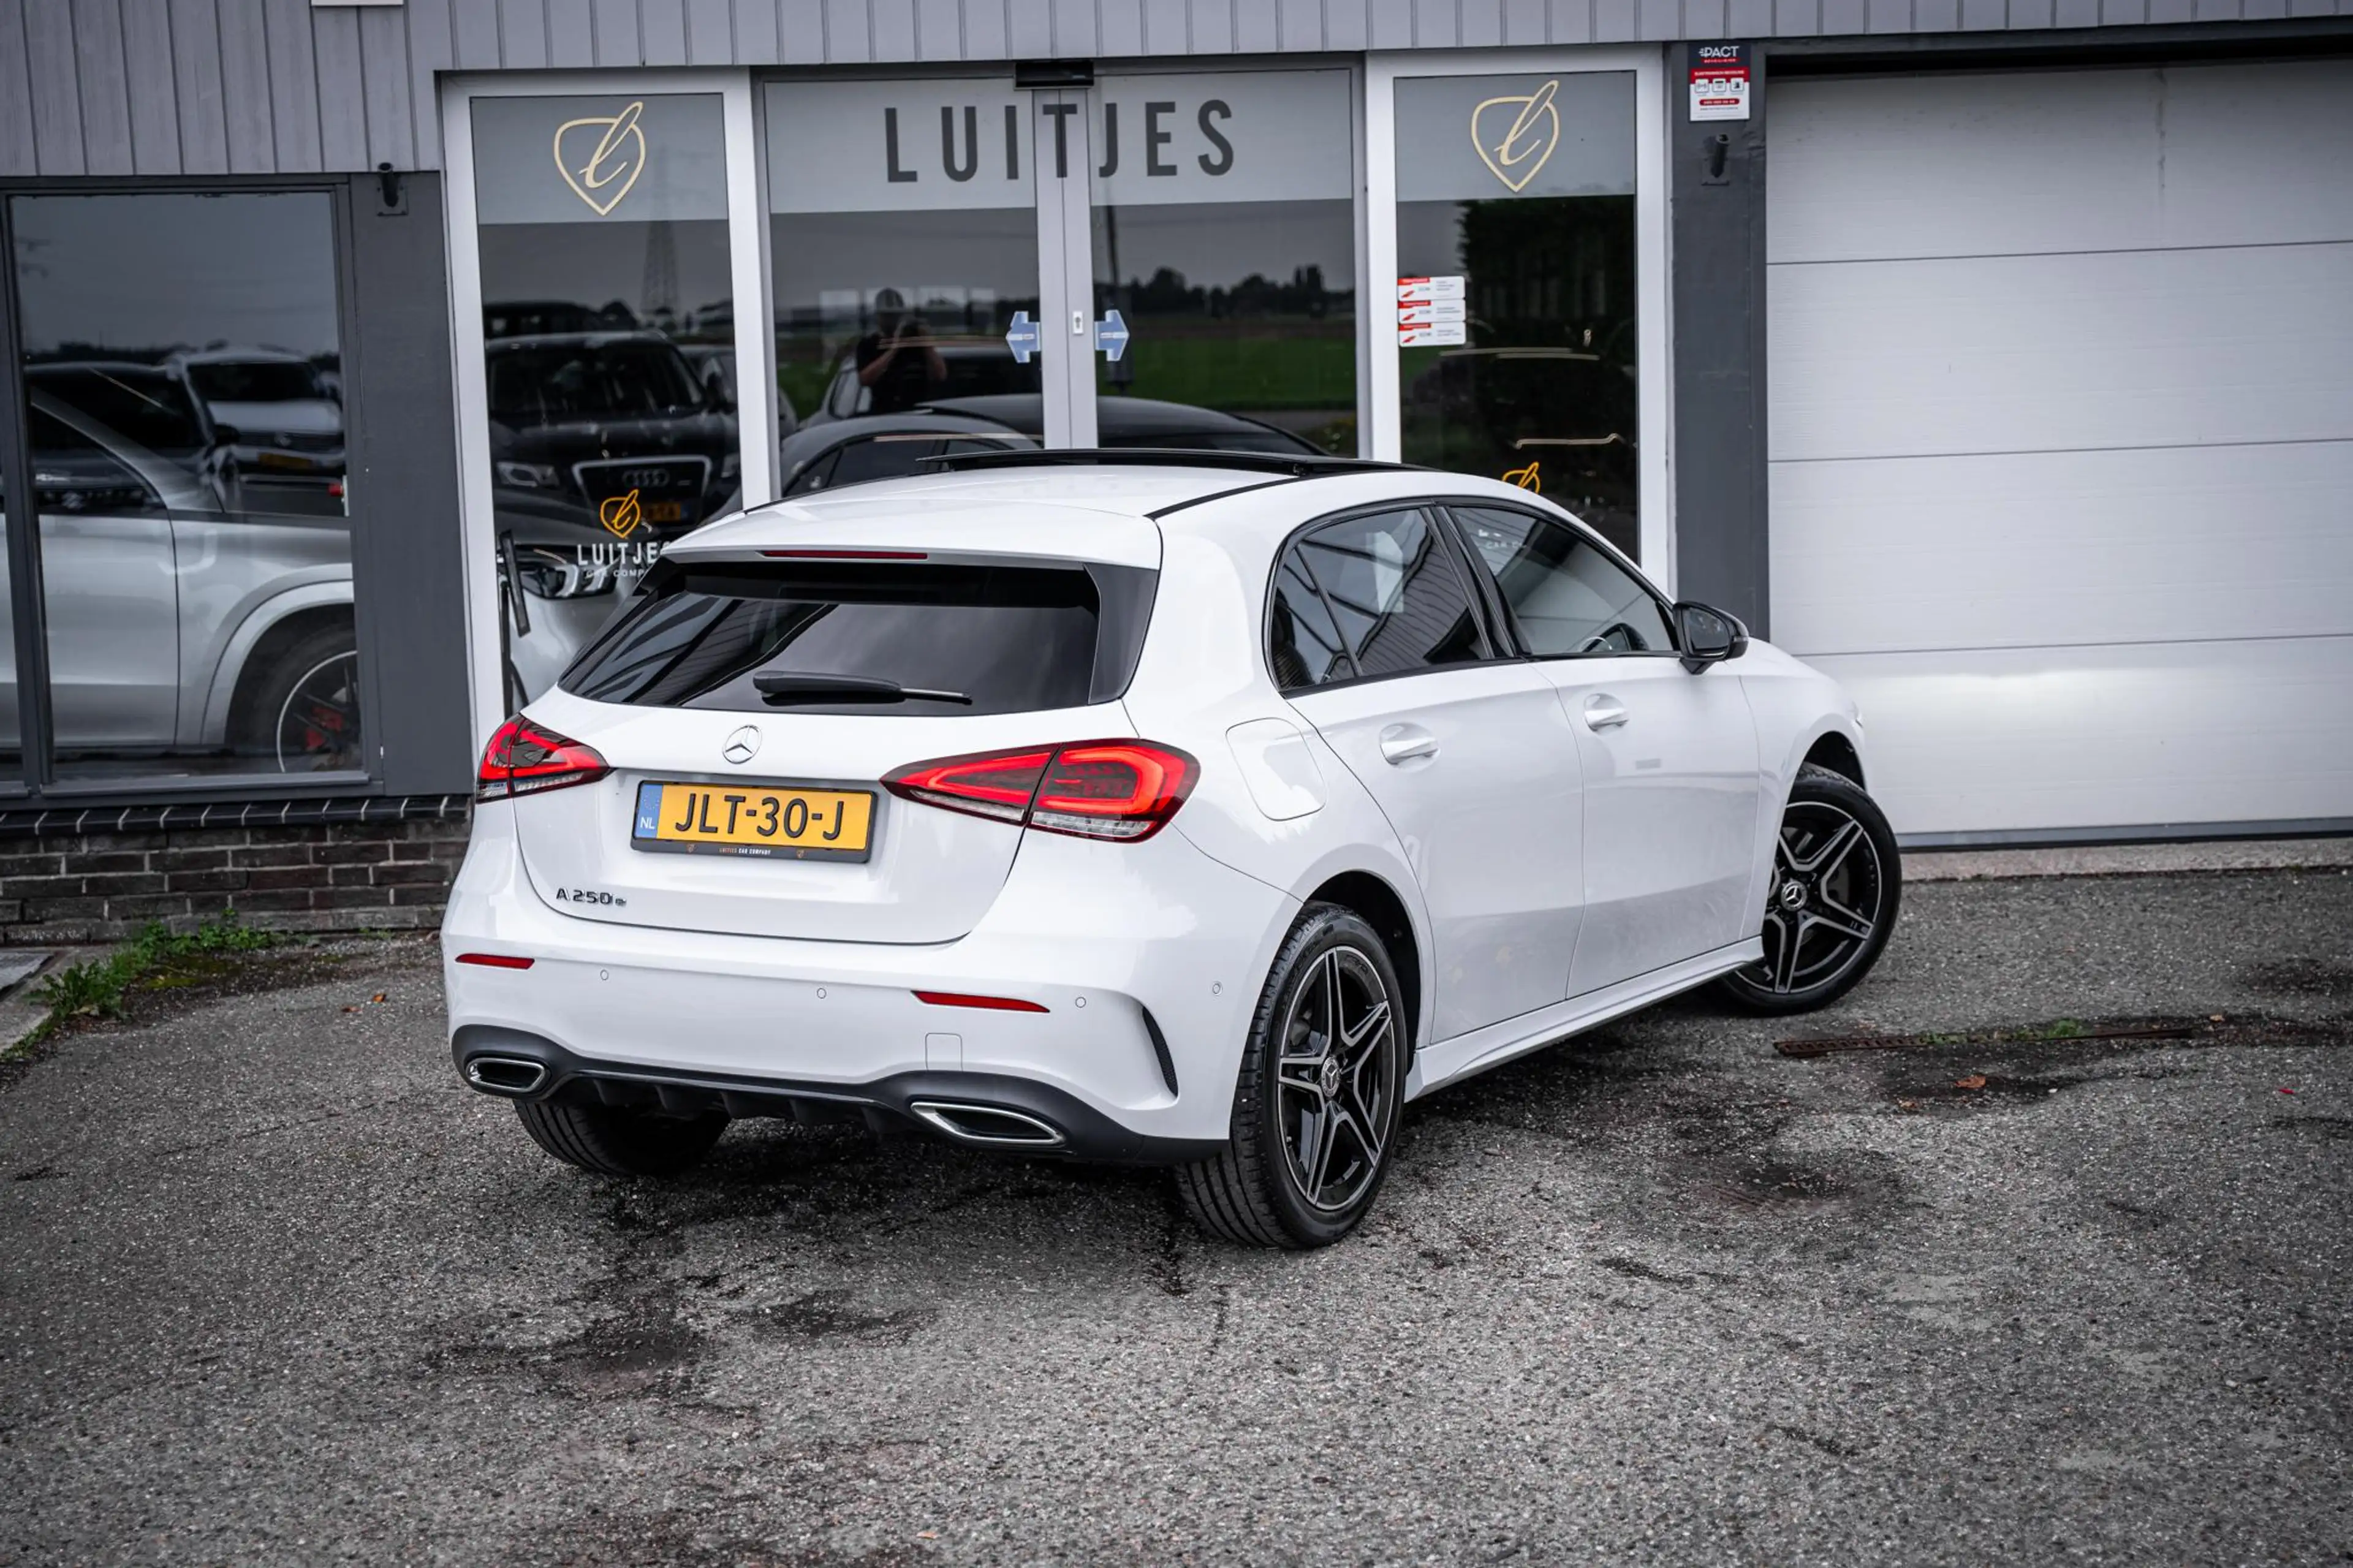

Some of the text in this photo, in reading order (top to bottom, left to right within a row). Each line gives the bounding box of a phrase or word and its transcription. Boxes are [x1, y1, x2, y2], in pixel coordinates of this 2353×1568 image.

[885, 99, 1233, 182] LUITJES
[577, 541, 672, 565] LUITJE
[640, 793, 844, 841] NL JLT-30-J
